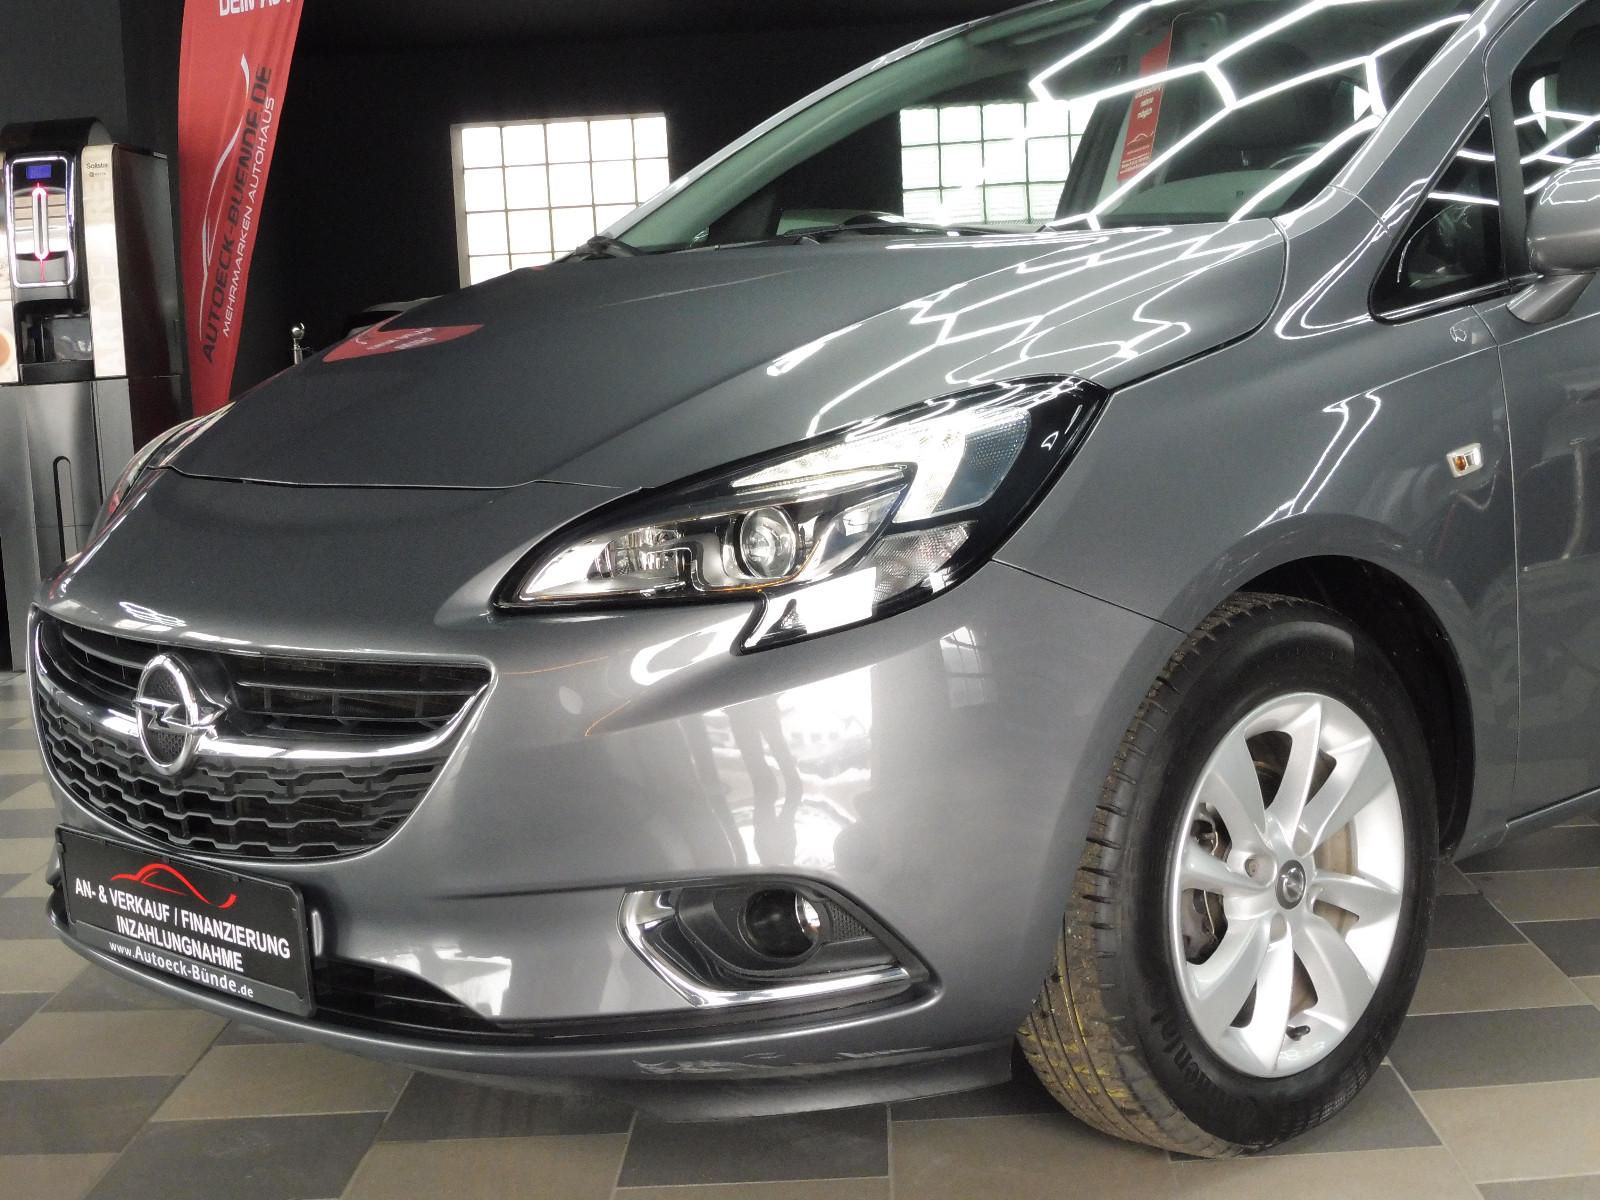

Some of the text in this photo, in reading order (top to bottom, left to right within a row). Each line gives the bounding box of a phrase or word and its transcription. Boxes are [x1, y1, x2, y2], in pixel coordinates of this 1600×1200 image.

[223, 97, 275, 337] MEHRMARKEN AUTOHAUS
[75, 877, 96, 899] AN-
[98, 885, 108, 904] &
[109, 887, 170, 924] VERKAUF
[181, 910, 291, 959] FINANZIERUNG
[116, 915, 244, 972] INZAHLUNGNAHME
[109, 941, 254, 998] www.Autoeck-Bünde.de
